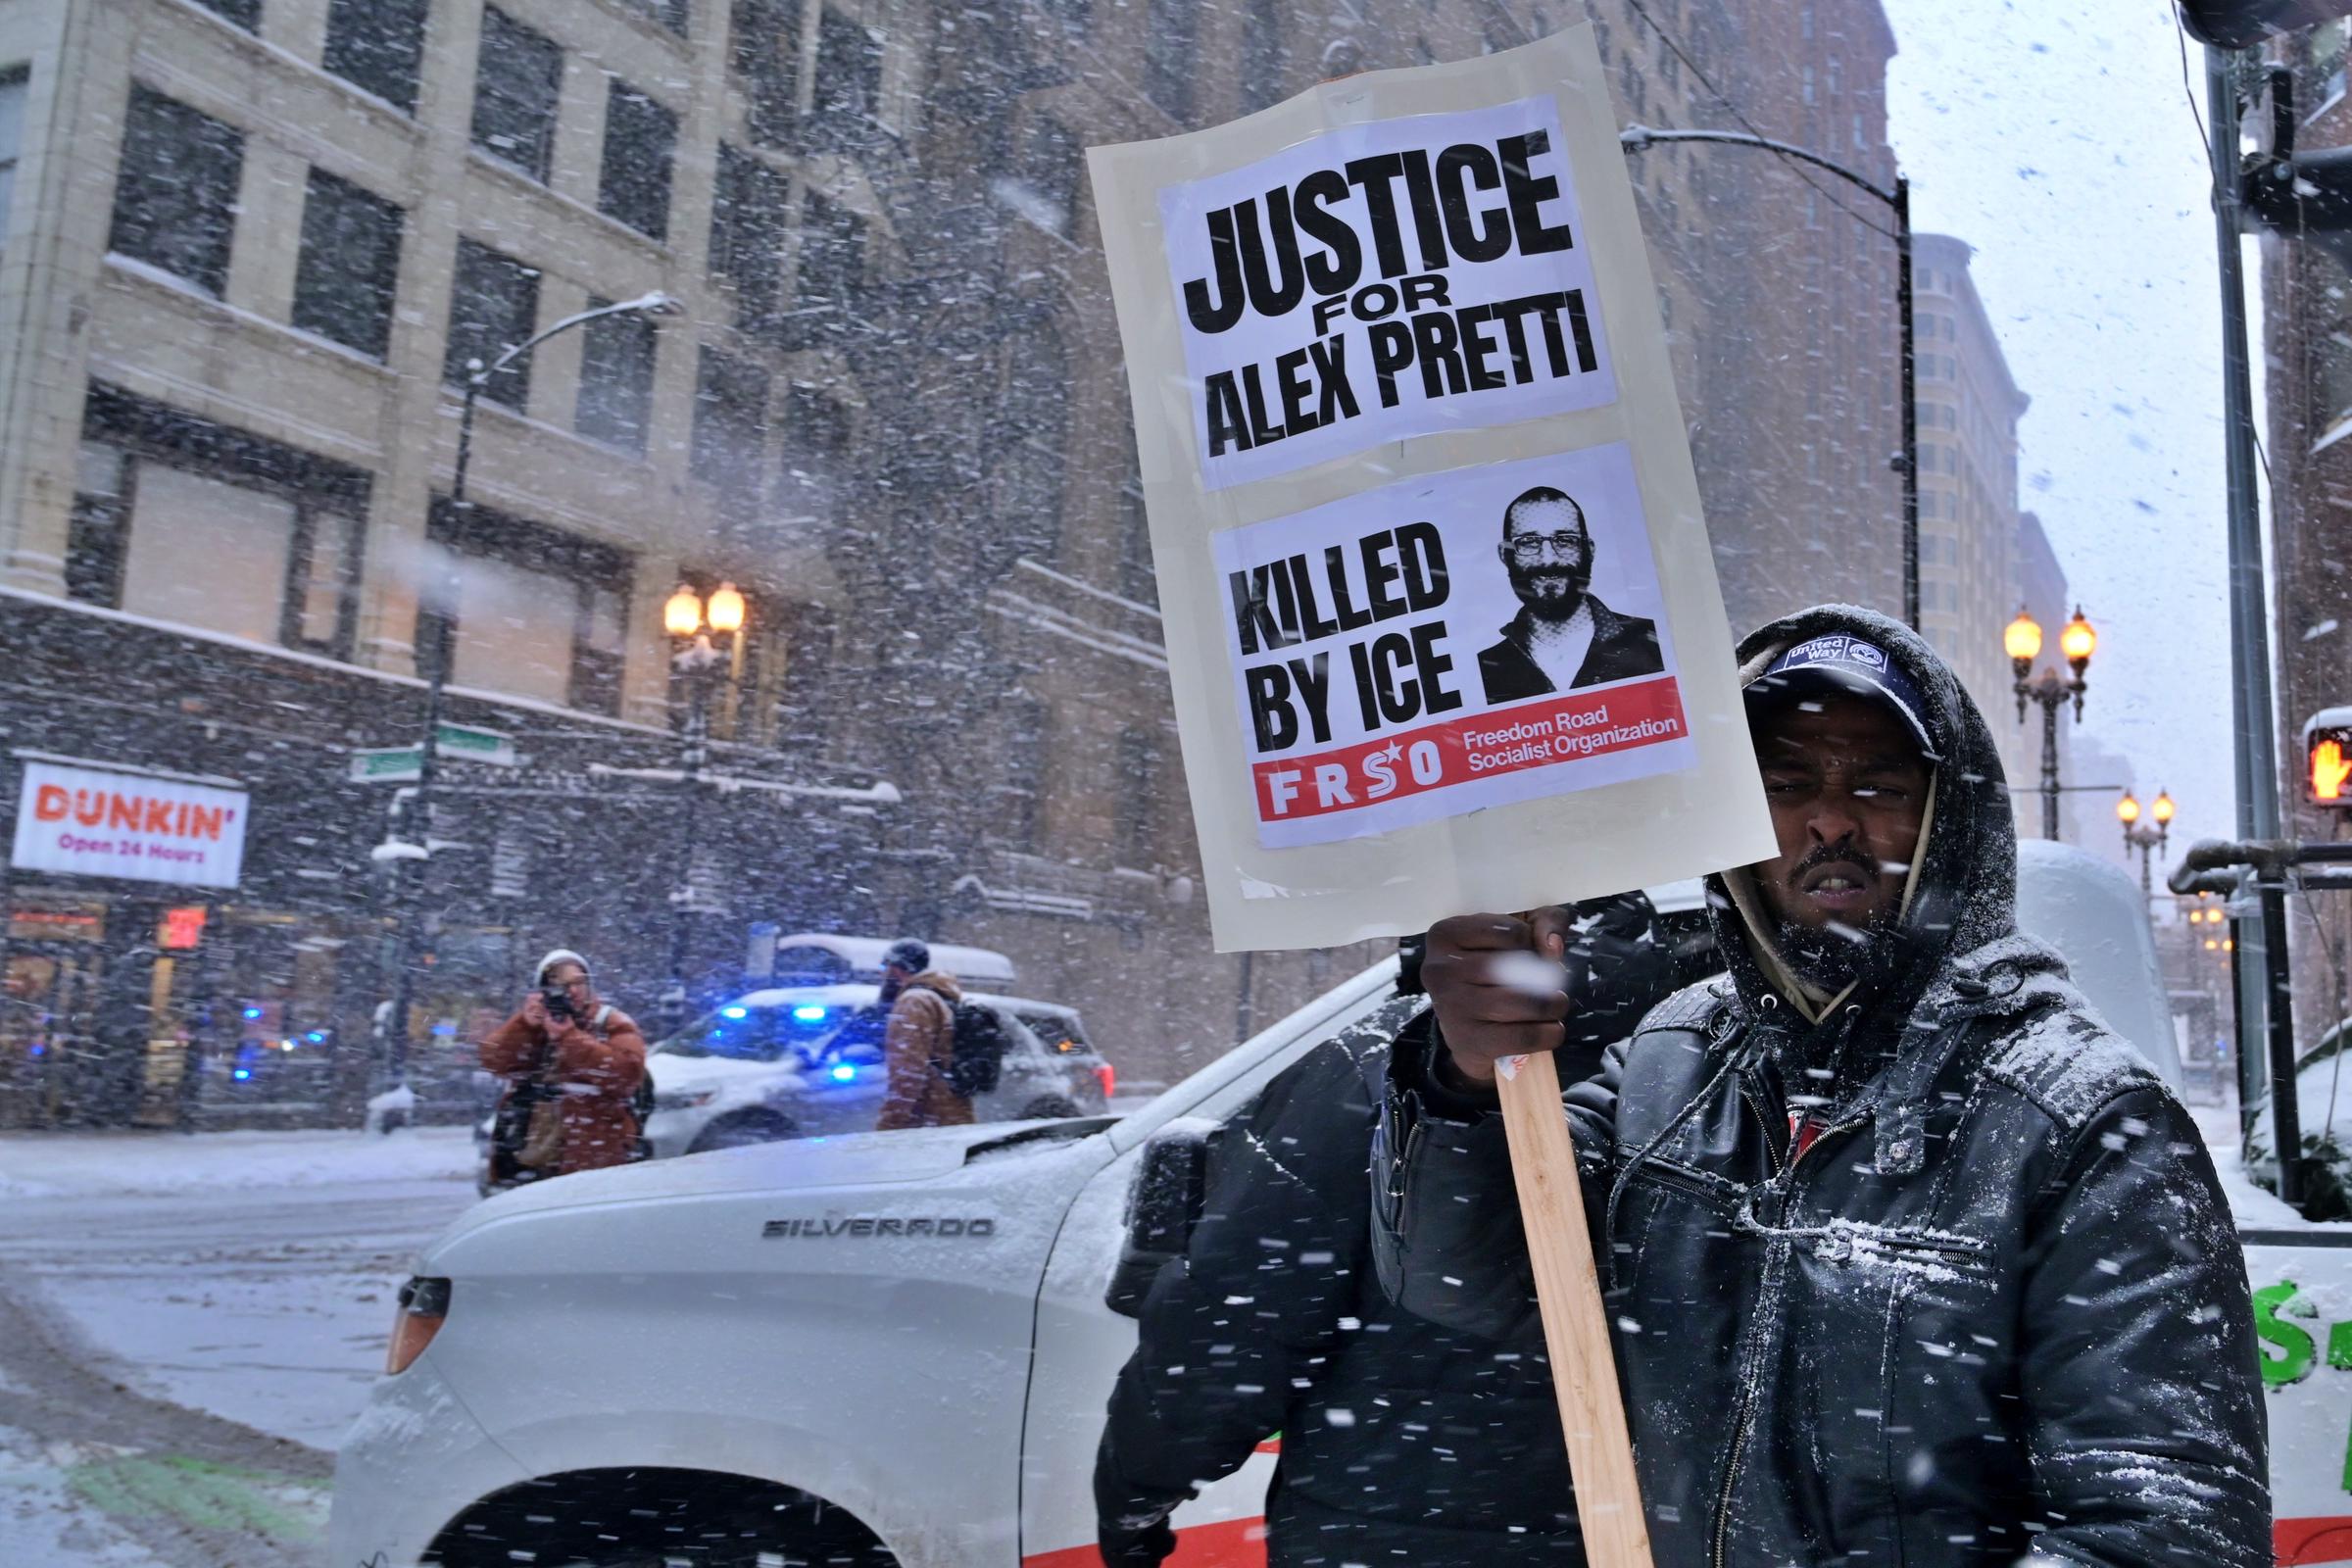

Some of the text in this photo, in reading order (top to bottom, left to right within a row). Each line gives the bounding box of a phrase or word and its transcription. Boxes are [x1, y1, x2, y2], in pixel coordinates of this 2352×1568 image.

[1184, 128, 1573, 334] JUSTICE
[1312, 273, 1450, 336] FOR
[1205, 288, 1598, 458] ALEX PRETTI
[1228, 521, 1450, 657] KILLED
[1808, 648, 1841, 660] Way
[1245, 621, 1463, 753] BY ICE
[1463, 706, 1609, 751] Freedom Road
[1468, 715, 1679, 772] Socialist Organization
[1268, 740, 1444, 814] FRSO
[35, 783, 235, 841] DUNKIN'
[58, 833, 204, 863] Open 24 Hours
[761, 1218, 996, 1238] SILVERADO
